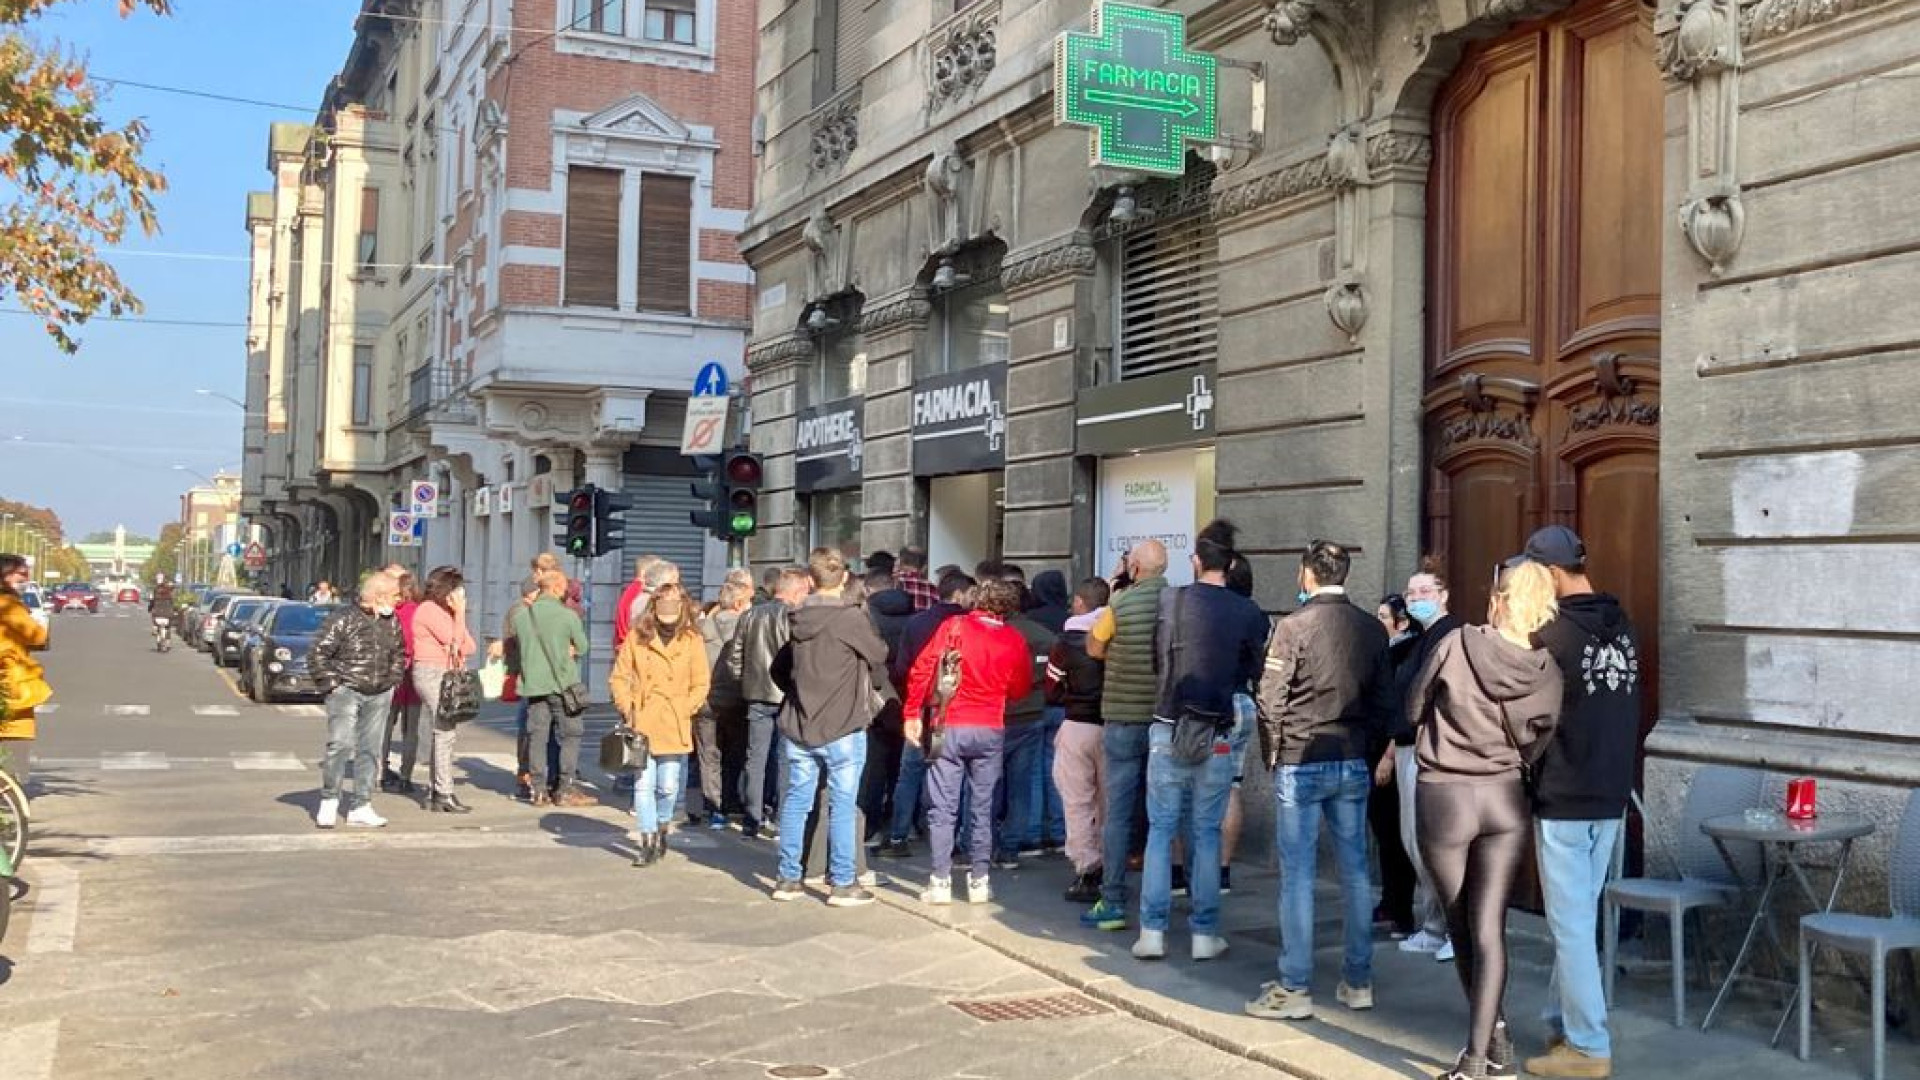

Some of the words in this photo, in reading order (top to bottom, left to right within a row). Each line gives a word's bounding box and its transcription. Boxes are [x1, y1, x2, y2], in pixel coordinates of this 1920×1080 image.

[1084, 60, 1199, 97] FARMACIA
[914, 379, 991, 425] FARMACIA
[797, 410, 855, 448] APOTHEKE
[1125, 480, 1162, 497] FARMACIA
